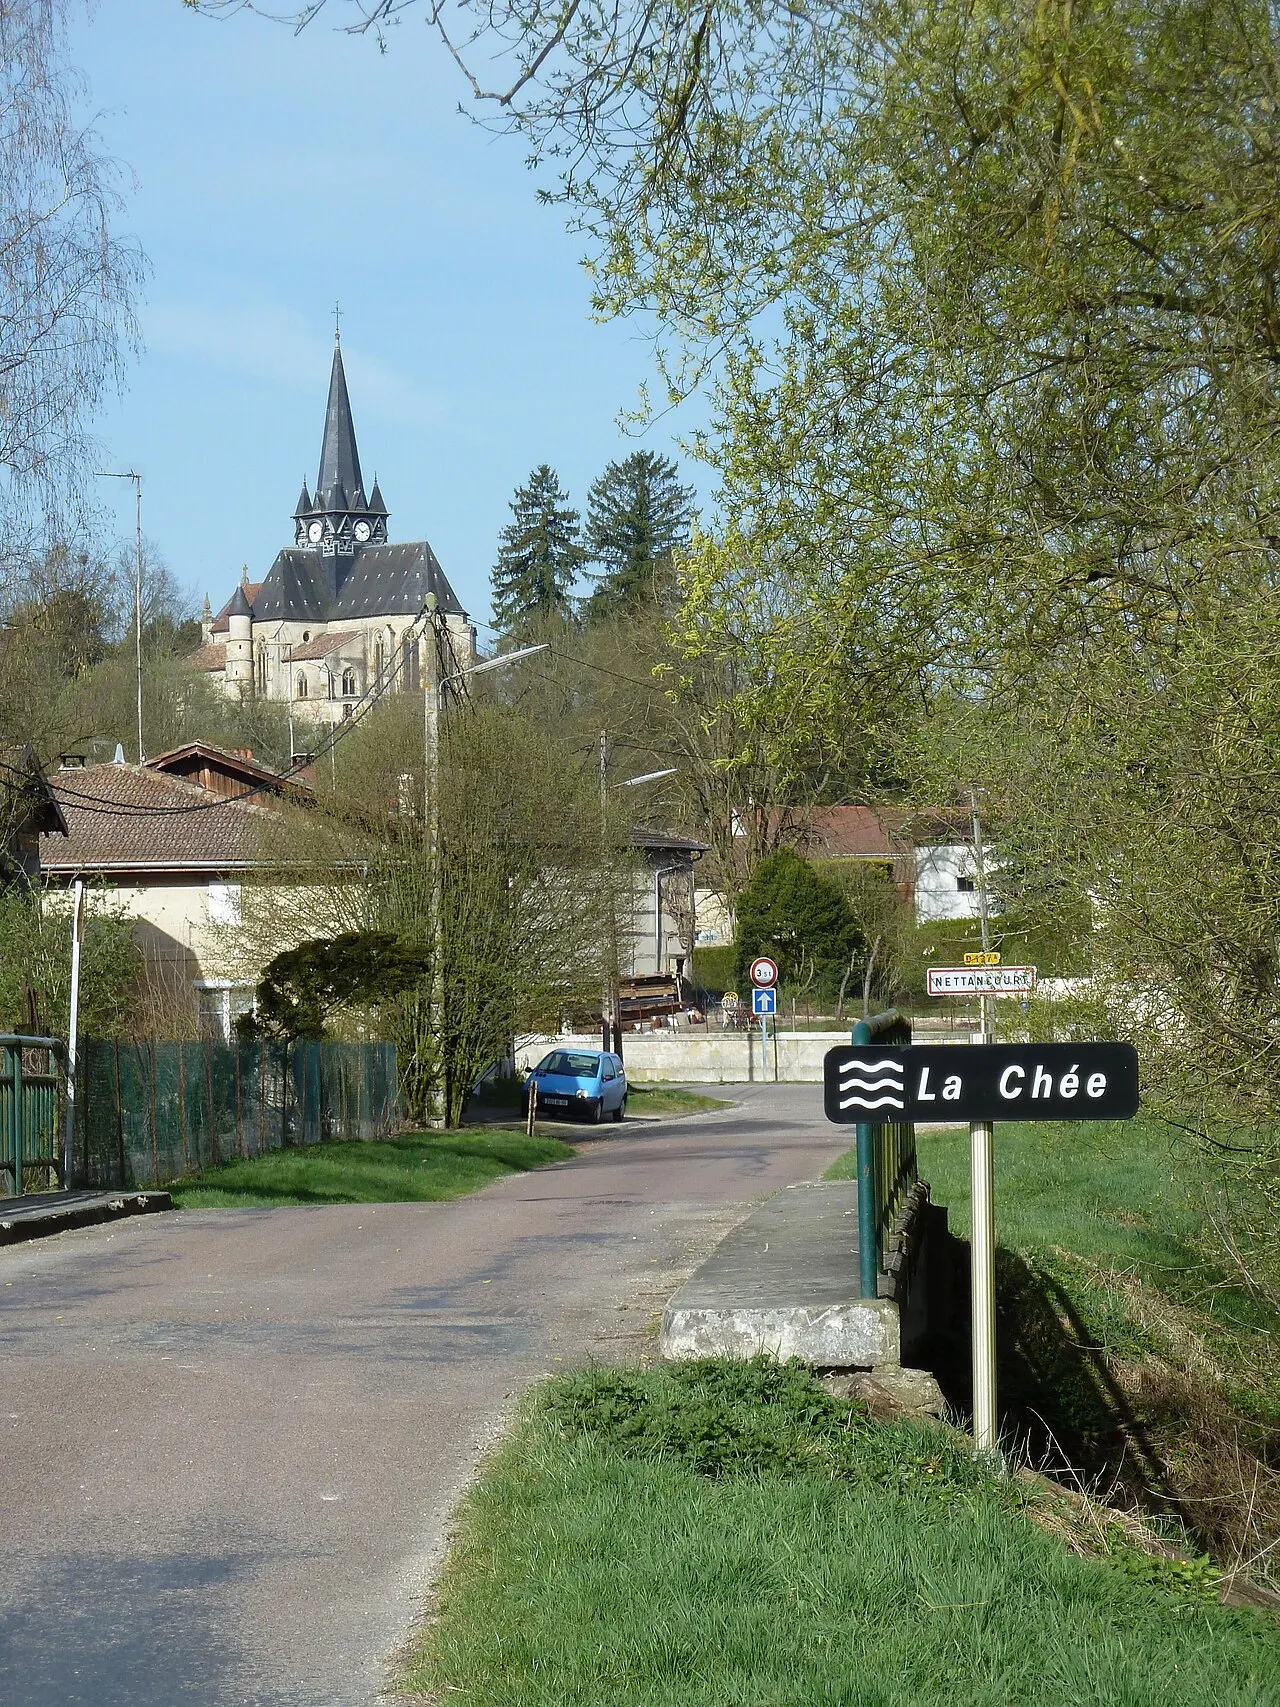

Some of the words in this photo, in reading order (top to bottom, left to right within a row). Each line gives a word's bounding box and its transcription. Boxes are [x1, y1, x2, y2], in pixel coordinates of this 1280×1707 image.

[935, 975, 1027, 987] NETTANCOURT
[917, 1066, 963, 1101] La
[999, 1064, 1107, 1100] Chée
